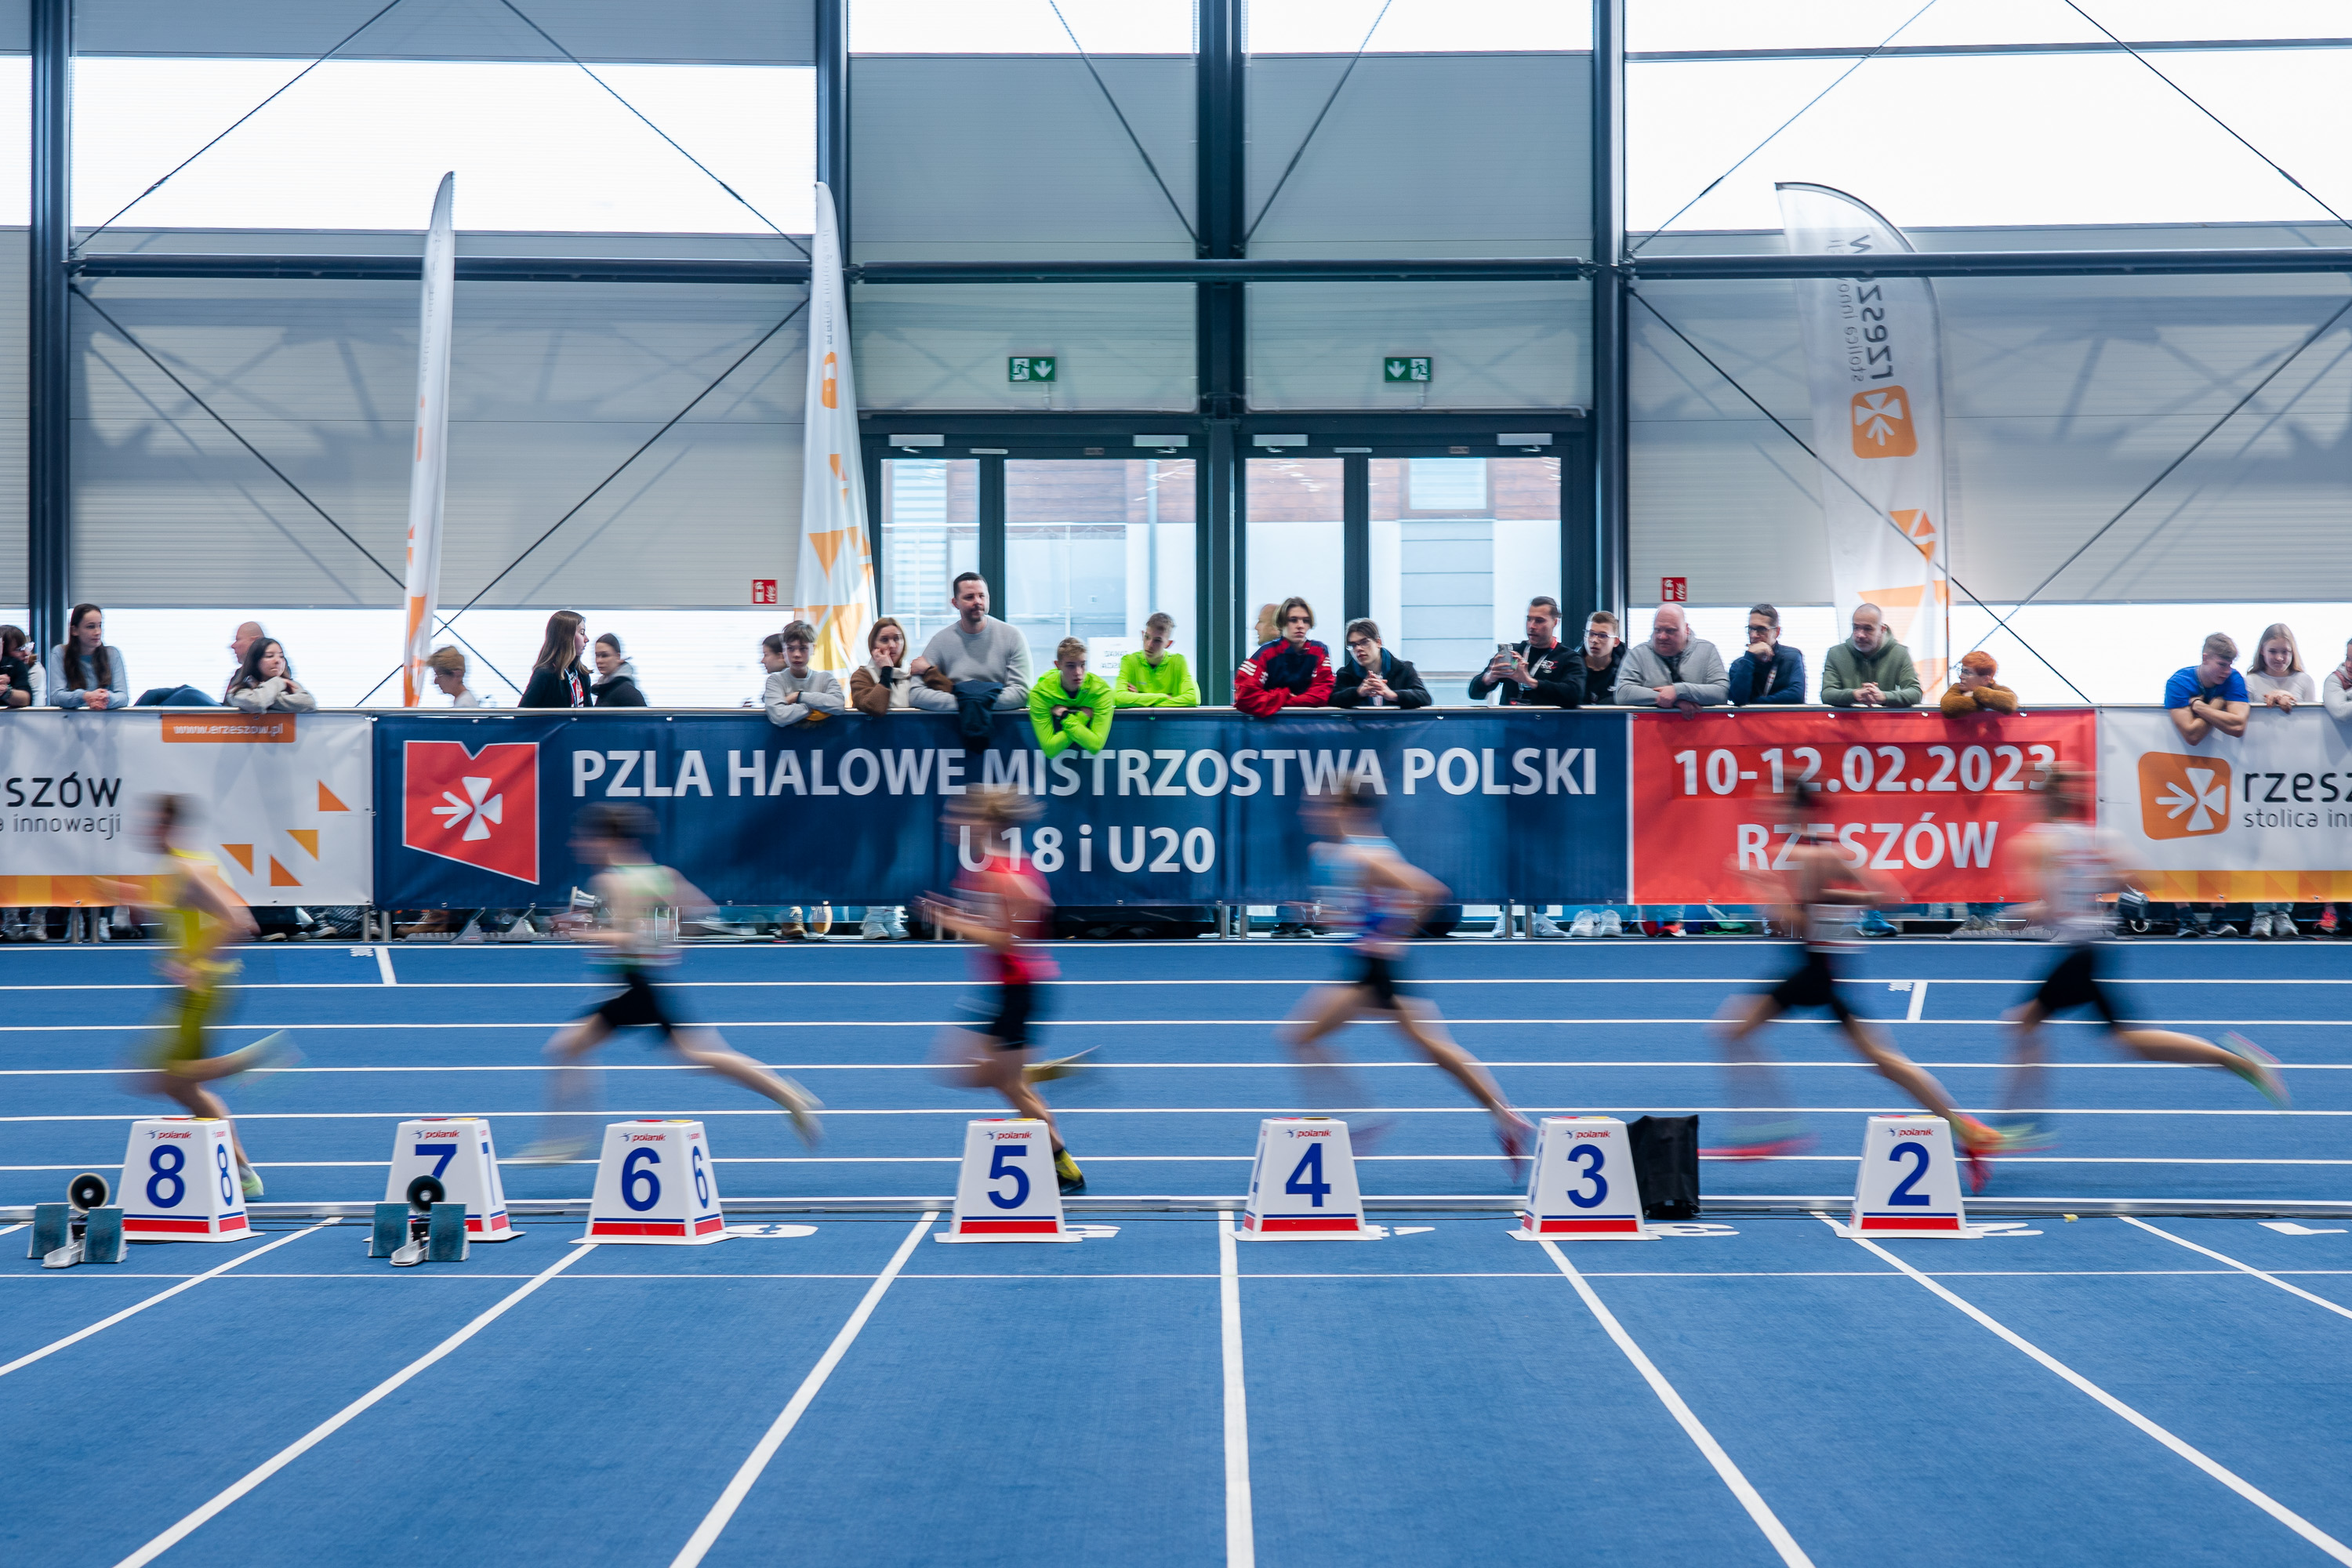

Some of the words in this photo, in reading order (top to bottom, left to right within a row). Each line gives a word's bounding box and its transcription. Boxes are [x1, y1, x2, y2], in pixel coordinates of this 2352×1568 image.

[173, 723, 284, 737] www.erzeszow.pl
[572, 750, 713, 797] PZLA
[728, 748, 967, 796] HALOWE
[982, 748, 1388, 797] MISTRZOSTWA
[1402, 747, 1597, 796] POLSKI
[1673, 744, 2056, 795] 10-12.02.2023
[0, 771, 122, 808] szów
[13, 813, 121, 840] innowacji
[2243, 808, 2319, 828] stolica
[2327, 808, 2352, 828] in
[958, 825, 1065, 873] U18
[1079, 824, 1092, 873] i
[1108, 826, 1216, 873] U20
[158, 1131, 192, 1140] polanik
[424, 1130, 460, 1140] polanik
[631, 1134, 666, 1143] polanik
[996, 1131, 1033, 1141] polanik
[1296, 1129, 1332, 1139] polanik
[1575, 1130, 1611, 1140] polanik
[1898, 1128, 1934, 1138] polanik
[147, 1144, 186, 1209] 8
[216, 1143, 233, 1207] 8
[414, 1143, 458, 1181] 7
[621, 1147, 662, 1212] 6
[691, 1145, 709, 1210] 6
[987, 1145, 1031, 1210] 5
[1284, 1142, 1332, 1207] 4
[1566, 1143, 1609, 1209] 3
[1887, 1142, 1931, 1207] 2
